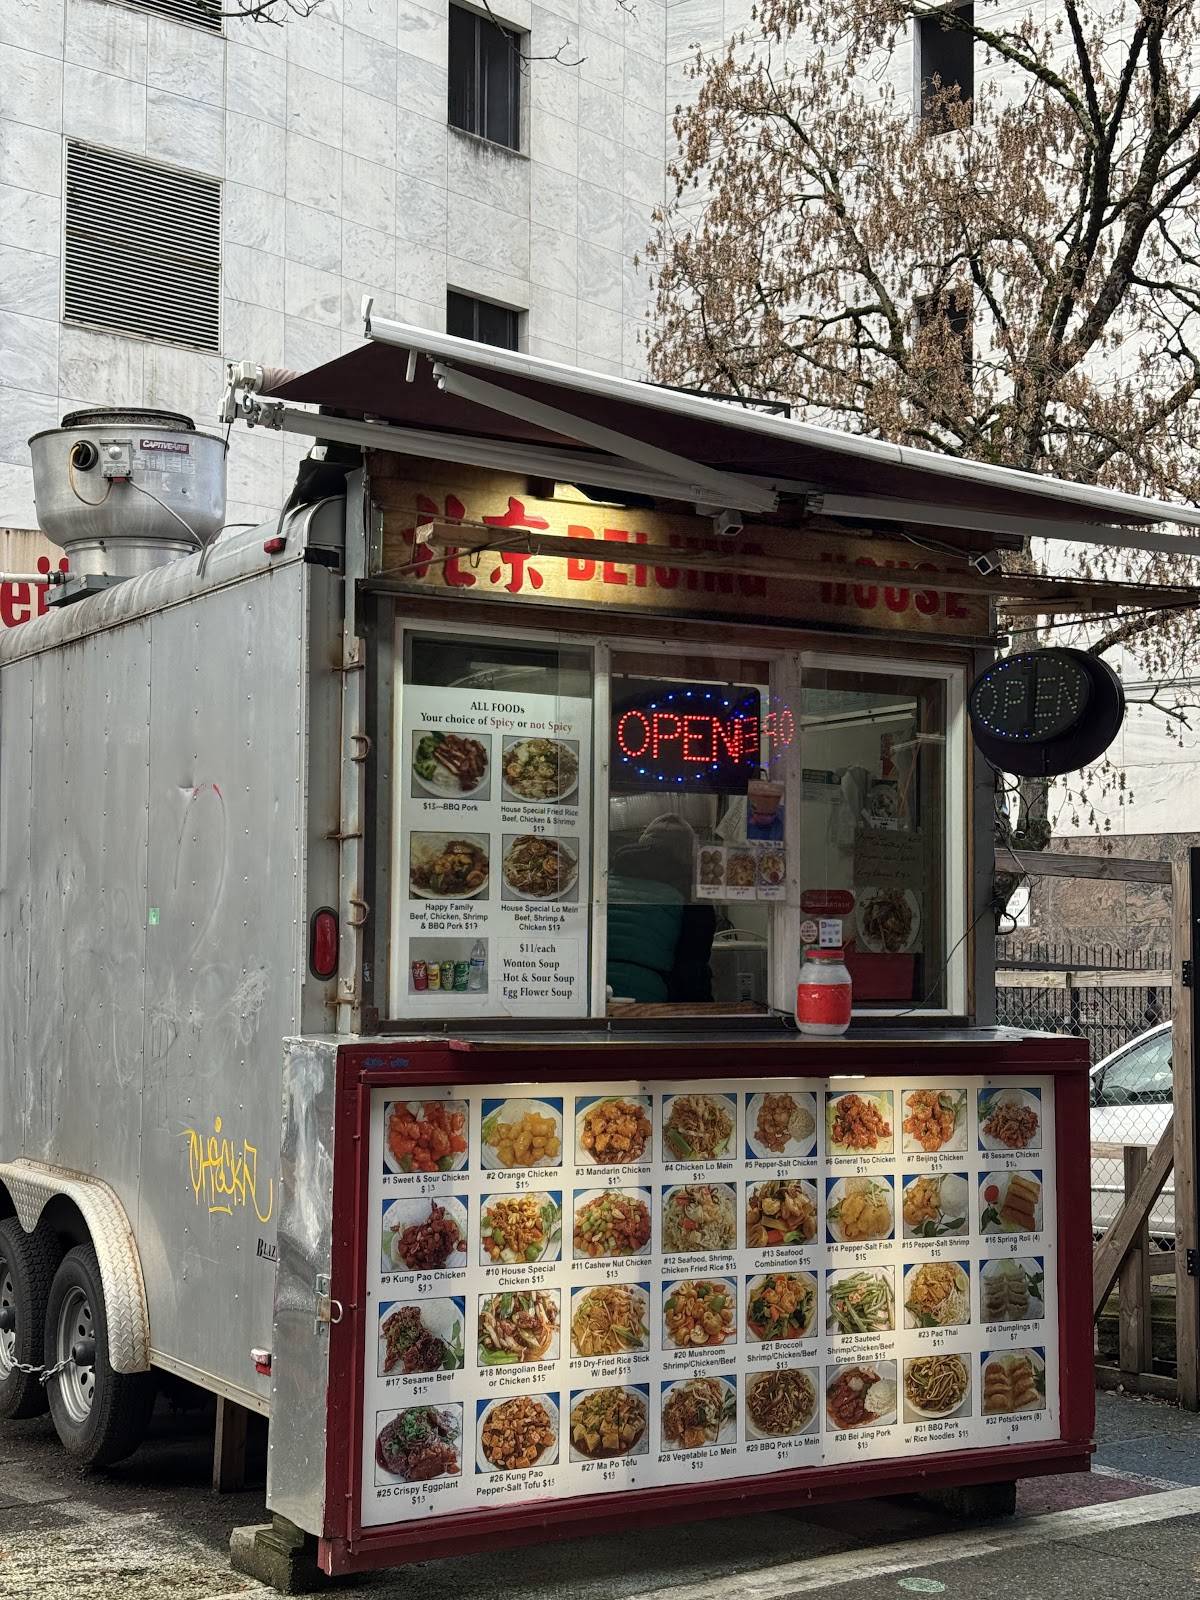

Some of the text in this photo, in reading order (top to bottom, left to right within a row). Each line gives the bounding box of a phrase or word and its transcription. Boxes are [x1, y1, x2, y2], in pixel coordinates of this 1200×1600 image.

[401, 493, 550, 594] 北京
[976, 675, 1080, 720] OPEN
[471, 702, 525, 714] ALL FOODs
[421, 712, 443, 722] Your
[446, 714, 475, 725] choice
[478, 716, 488, 725] of
[490, 717, 514, 729] Spicy
[530, 721, 545, 729] not
[548, 721, 572, 733] Spicy
[618, 710, 739, 763] OPEN
[523, 807, 545, 815] Special
[519, 816, 575, 826] Chicken Shrimp
[426, 903, 473, 912] Happy Family
[501, 904, 523, 912] House
[525, 905, 549, 913] Special
[463, 913, 488, 922] Shrimp
[534, 915, 558, 923] Shrimp
[503, 958, 560, 970] Wonton Soup
[503, 973, 519, 982] Hot
[531, 974, 551, 983] Sour
[553, 974, 574, 987] Soup
[503, 987, 572, 1000] Egg Flower Soup
[835, 1157, 857, 1165] General
[858, 1156, 870, 1164] Tso
[916, 1154, 964, 1163] Beijing Chicken
[991, 1151, 1039, 1160] Sesame Chicken
[755, 1160, 790, 1169] Pepper-Salt
[486, 1170, 557, 1181] #2 Orange Chicken
[576, 1168, 584, 1176] #3
[587, 1168, 619, 1176] Mandarin
[383, 1176, 390, 1184] #1
[393, 1175, 414, 1184] Sweet
[423, 1174, 439, 1182] Sour
[949, 1239, 969, 1247] Shrimp
[998, 1236, 1017, 1244] Spring
[840, 1244, 877, 1252] Pepper-Salt
[762, 1249, 803, 1258] #13 Seafood
[856, 1253, 866, 1261] $15
[572, 1262, 582, 1270] #11
[585, 1261, 610, 1269] Cashew
[626, 1258, 652, 1266] Chicken
[664, 1257, 675, 1265] #12
[755, 1258, 797, 1268] Combination
[486, 1265, 556, 1276] #10 House Special
[661, 1263, 724, 1274] Chicken Fried Rice
[381, 1272, 465, 1284] #9 Kung Pao Chicken
[499, 1277, 529, 1286] Chicken
[945, 1328, 958, 1336] Thai
[999, 1324, 1031, 1332] Dumplings
[855, 1334, 880, 1342] Sauteed
[762, 1341, 803, 1351] #21 Broccoli
[688, 1349, 725, 1358] Mushroom
[569, 1361, 581, 1369] #19
[584, 1357, 615, 1368] Dry-Fried
[617, 1357, 631, 1365] Rice
[663, 1357, 736, 1370] Shrimp/Chicken/Beef
[480, 1364, 555, 1377] #18 Mongolian Beef
[602, 1368, 617, 1376] Beef
[386, 1373, 454, 1387] #17 Sesame Beef
[500, 1376, 530, 1386] Chicken
[999, 1414, 1032, 1424] Potstickers
[928, 1423, 942, 1432] BBQ
[1012, 1424, 1018, 1432] $9
[835, 1434, 846, 1442] #30
[861, 1432, 874, 1441] Jing
[913, 1435, 927, 1443] Rice
[929, 1432, 954, 1441] Noodles
[760, 1442, 775, 1451] BBQ
[805, 1438, 819, 1446] Mein
[658, 1447, 736, 1463] #28 Vegetable Lo Mein
[582, 1459, 637, 1472] #27 Ma Po Tofu
[490, 1470, 543, 1483] #26 Kung Pao
[377, 1481, 458, 1498] #25 Crispy Eggplant
[477, 1483, 522, 1496] Pepper-Salt
[525, 1481, 540, 1489] Tofu
